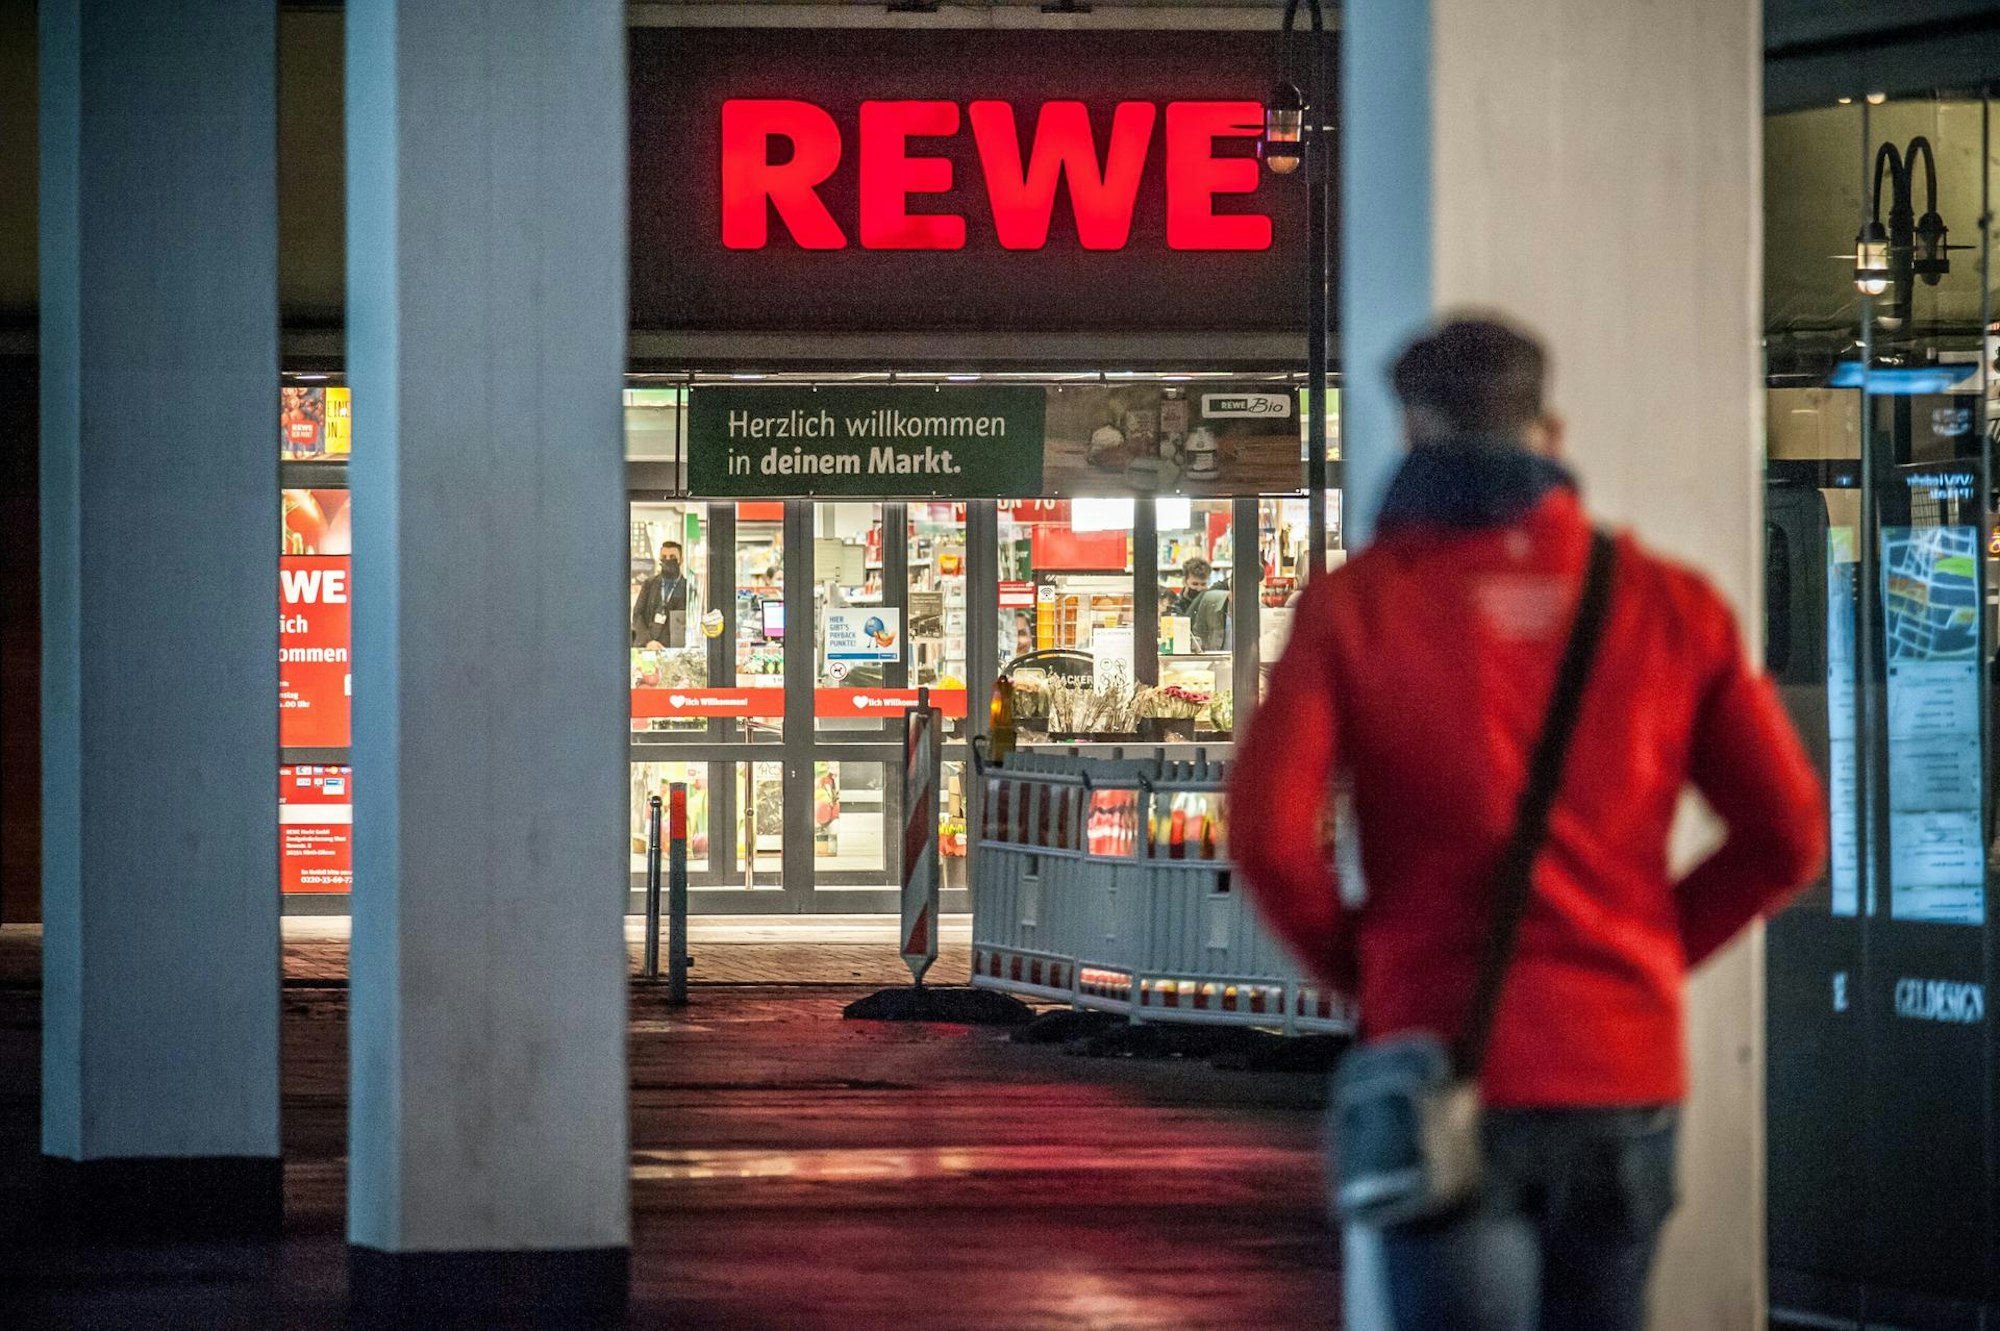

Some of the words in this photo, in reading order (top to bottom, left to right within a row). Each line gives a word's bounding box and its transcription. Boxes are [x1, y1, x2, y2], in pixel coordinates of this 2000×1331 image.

[720, 98, 1273, 251] REWE
[1220, 401, 1246, 409] REWE
[1248, 398, 1284, 413] Bio
[728, 410, 835, 438] Herzlich
[846, 410, 1006, 437] willkommen
[728, 448, 750, 475] in
[760, 446, 861, 475] deinem
[867, 446, 962, 475] Markt.
[280, 569, 347, 604] WE
